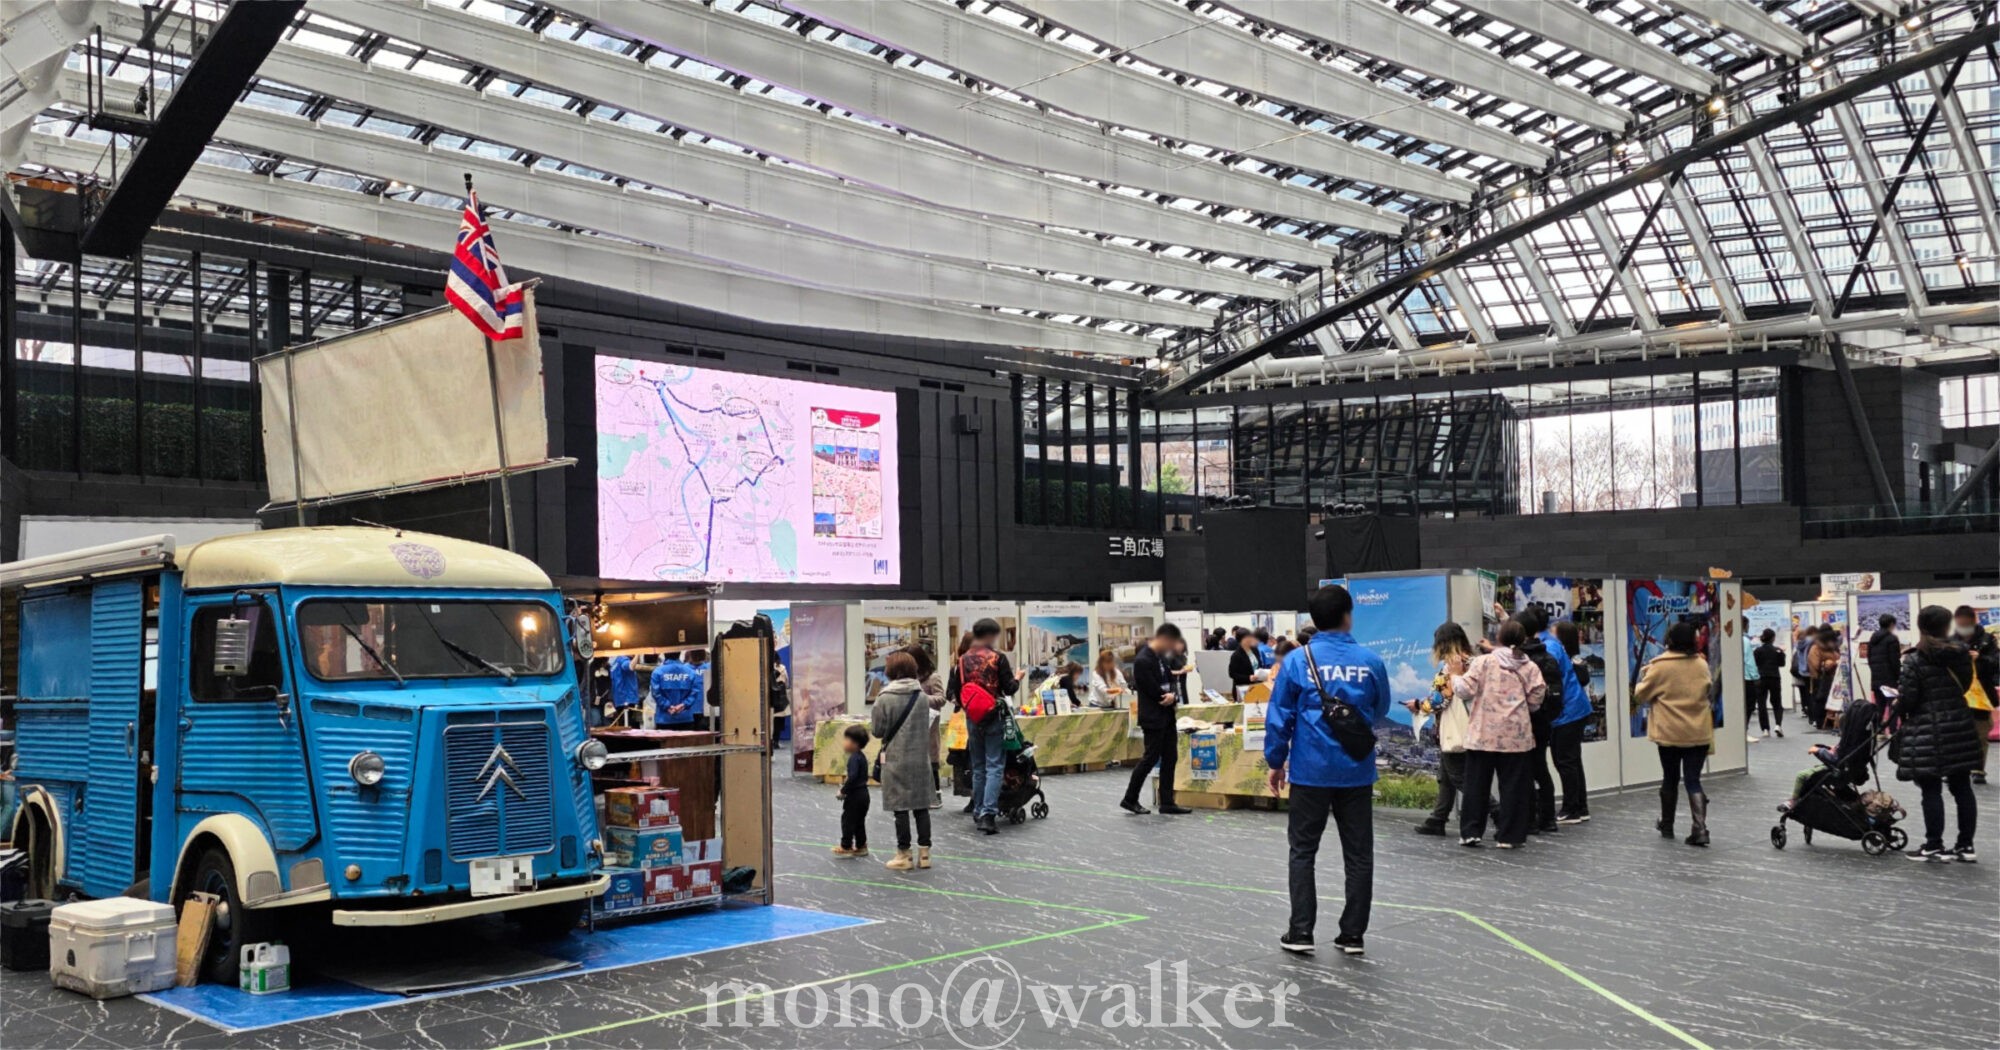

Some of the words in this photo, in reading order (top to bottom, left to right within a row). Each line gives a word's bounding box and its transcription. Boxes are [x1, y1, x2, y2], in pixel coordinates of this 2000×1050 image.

[1911, 442, 1920, 460] 2
[1109, 536, 1164, 558] 三角広場
[663, 673, 689, 681] STAFF
